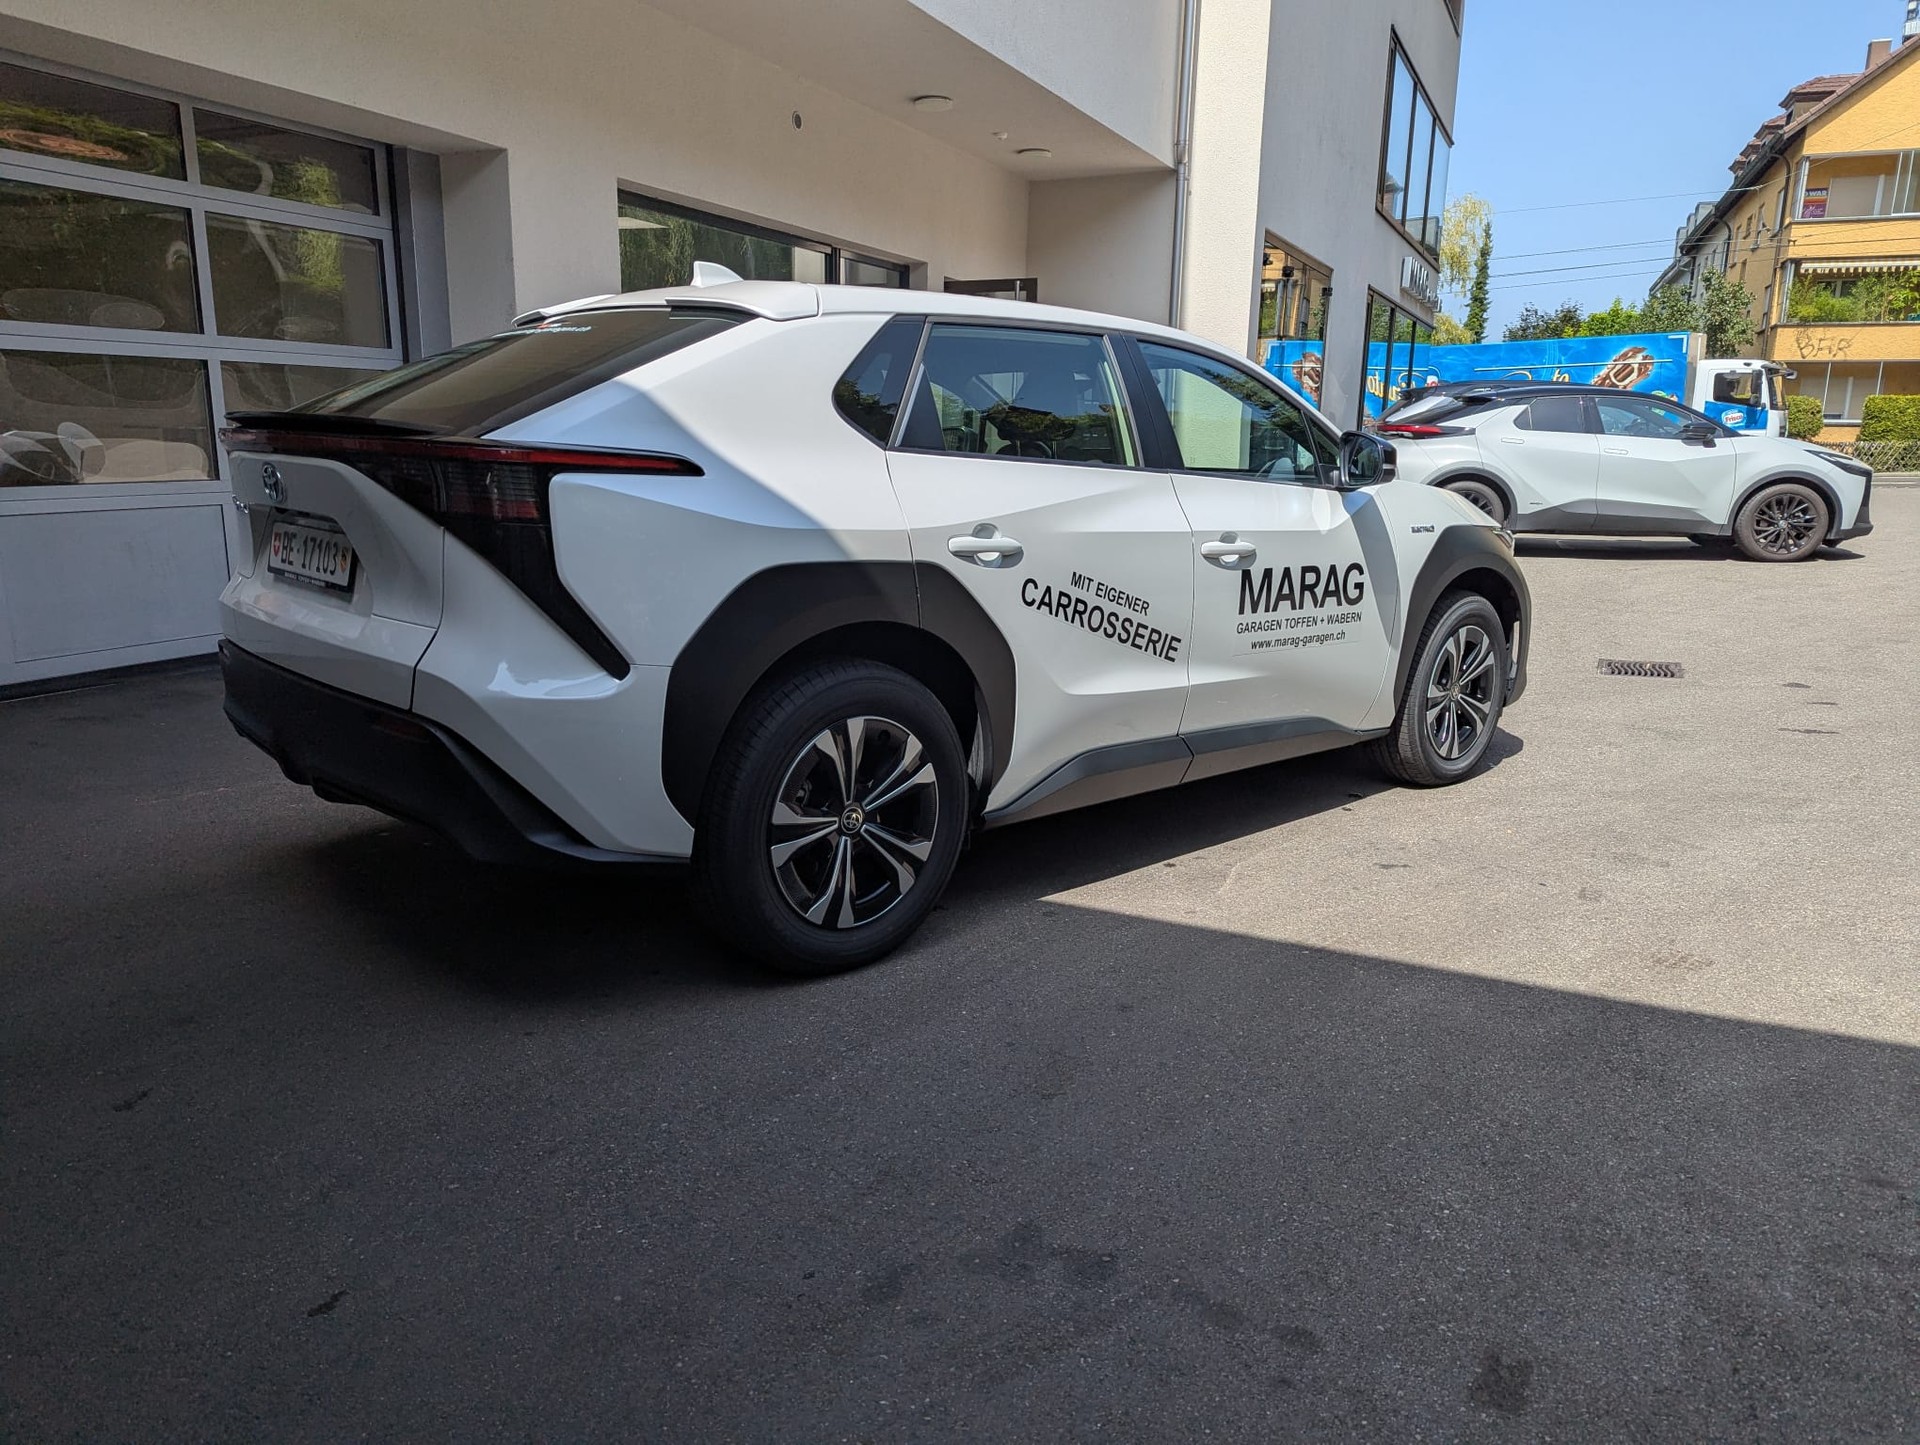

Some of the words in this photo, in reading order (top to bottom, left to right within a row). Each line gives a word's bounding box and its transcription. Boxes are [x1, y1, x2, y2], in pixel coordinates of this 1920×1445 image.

[301, 535, 339, 576] 17103
[1070, 571, 1094, 593] MIT
[1095, 581, 1150, 616] EIGENER
[1238, 562, 1365, 615] MARAG
[1021, 577, 1182, 663] CARROSSERIE
[1236, 618, 1282, 634] GARAGEN
[1284, 615, 1318, 630] TOFFEN
[1326, 611, 1362, 626] WABERN
[1251, 629, 1346, 650] www.marag-garagen.ch
